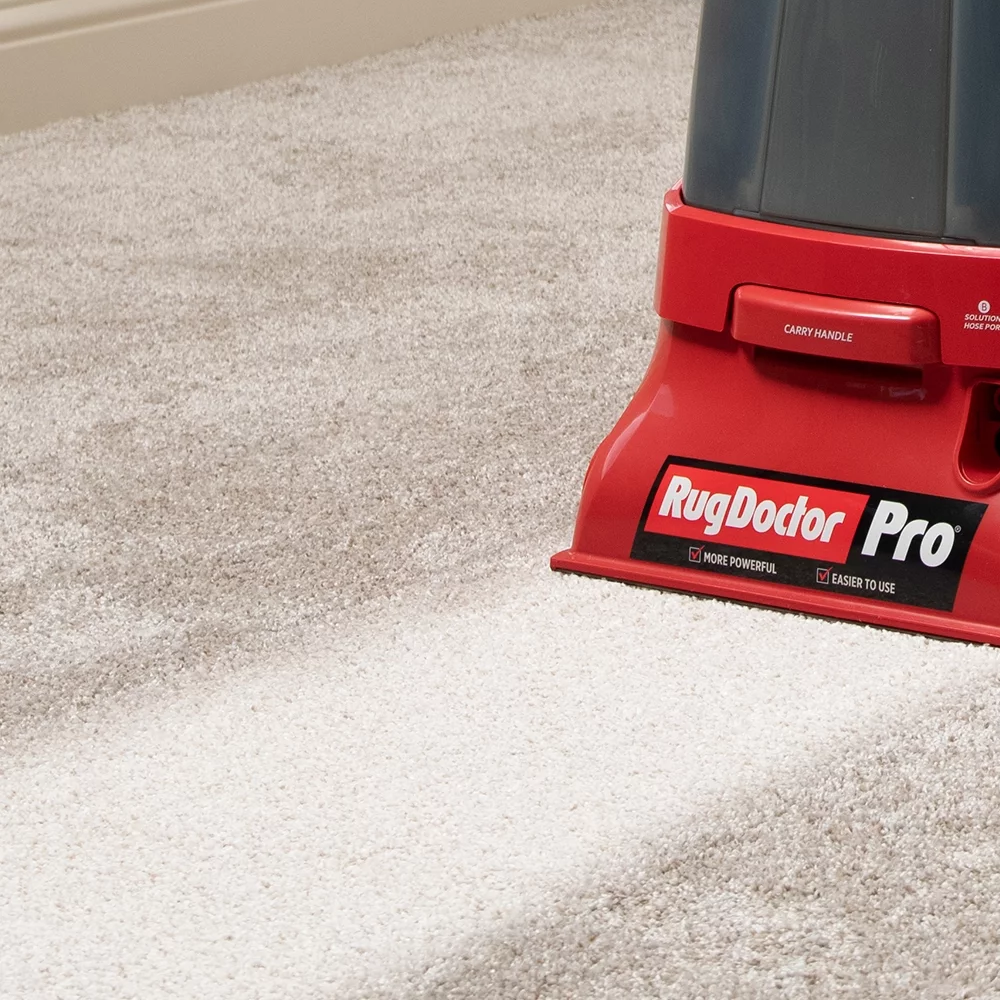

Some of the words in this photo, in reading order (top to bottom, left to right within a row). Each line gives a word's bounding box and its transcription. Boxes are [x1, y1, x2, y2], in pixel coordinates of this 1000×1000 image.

[784, 324, 813, 337] CARRY
[814, 328, 853, 343] HANDLE
[963, 322, 985, 330] HOSE
[658, 475, 847, 543] RugDoctor
[703, 551, 728, 567] MORE
[729, 555, 777, 575] POWERFUL
[832, 572, 863, 589] EASIER
[864, 578, 877, 591] TO
[878, 580, 896, 594] USE
